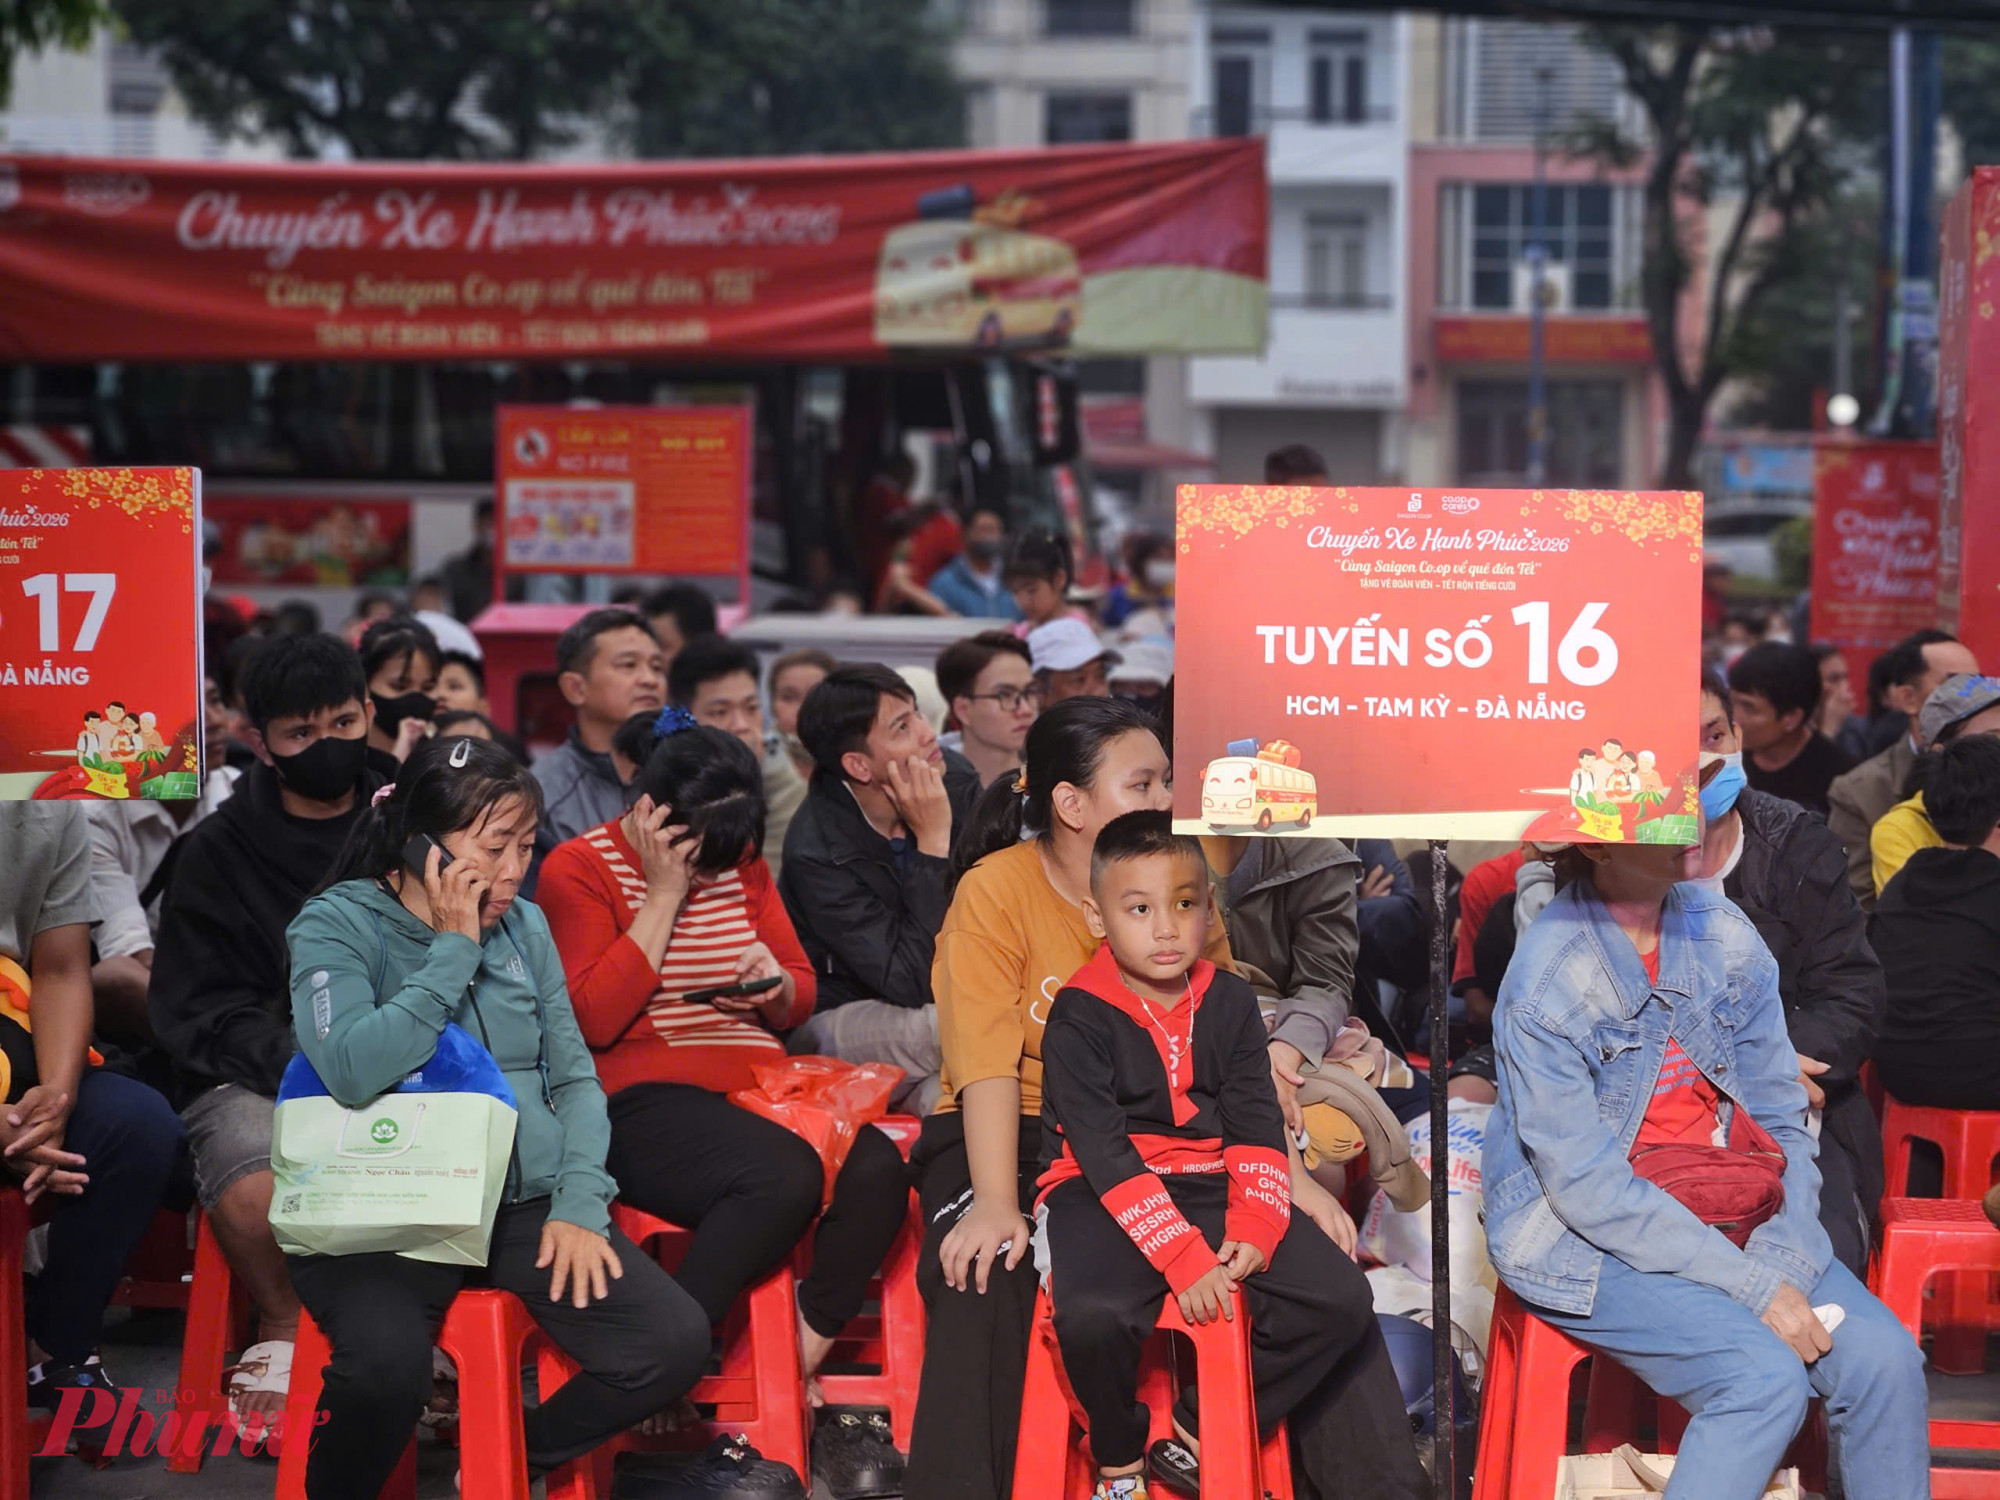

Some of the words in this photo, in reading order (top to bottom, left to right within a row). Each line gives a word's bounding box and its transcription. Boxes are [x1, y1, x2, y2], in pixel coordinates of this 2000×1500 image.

[177, 188, 366, 269] Chuyến
[374, 188, 458, 249] Xe
[0, 506, 30, 527] húc
[31, 513, 70, 527] 2026
[1306, 525, 1382, 556] Chuyến
[1385, 526, 1417, 550] Xe
[1420, 527, 1473, 553] Hạnh
[1476, 528, 1529, 552] Phúc
[1528, 537, 1570, 553] 2026
[1374, 559, 1417, 577] Saigon
[1419, 560, 1451, 577] Co.op
[1453, 560, 1469, 575] về
[1468, 561, 1491, 578] quê
[1492, 562, 1515, 575] đón
[1360, 577, 1380, 590] TẶNG
[1380, 577, 1392, 589] VÉ
[1392, 578, 1414, 589] ĐOÀN
[1415, 578, 1433, 589] VIÊN
[1441, 578, 1456, 590] TẾT
[1456, 578, 1474, 591] RỘN
[1475, 578, 1497, 590] TIẾNG
[1497, 579, 1516, 591] CƯỜI
[21, 573, 116, 652] 17
[1255, 613, 1409, 667] TUYẾN
[1423, 614, 1493, 668] SỐ
[1510, 601, 1619, 687] 16
[24, 659, 90, 686] NẴNG
[1286, 695, 1340, 716] HCM
[1363, 696, 1413, 717] TAM
[1420, 693, 1451, 718] KỲ
[1475, 694, 1511, 719] ĐÀ
[1516, 691, 1586, 720] NẴNG
[1446, 1156, 1483, 1184] ife
[1245, 1186, 1291, 1220] AHDYH
[1129, 1208, 1177, 1242] SESRH
